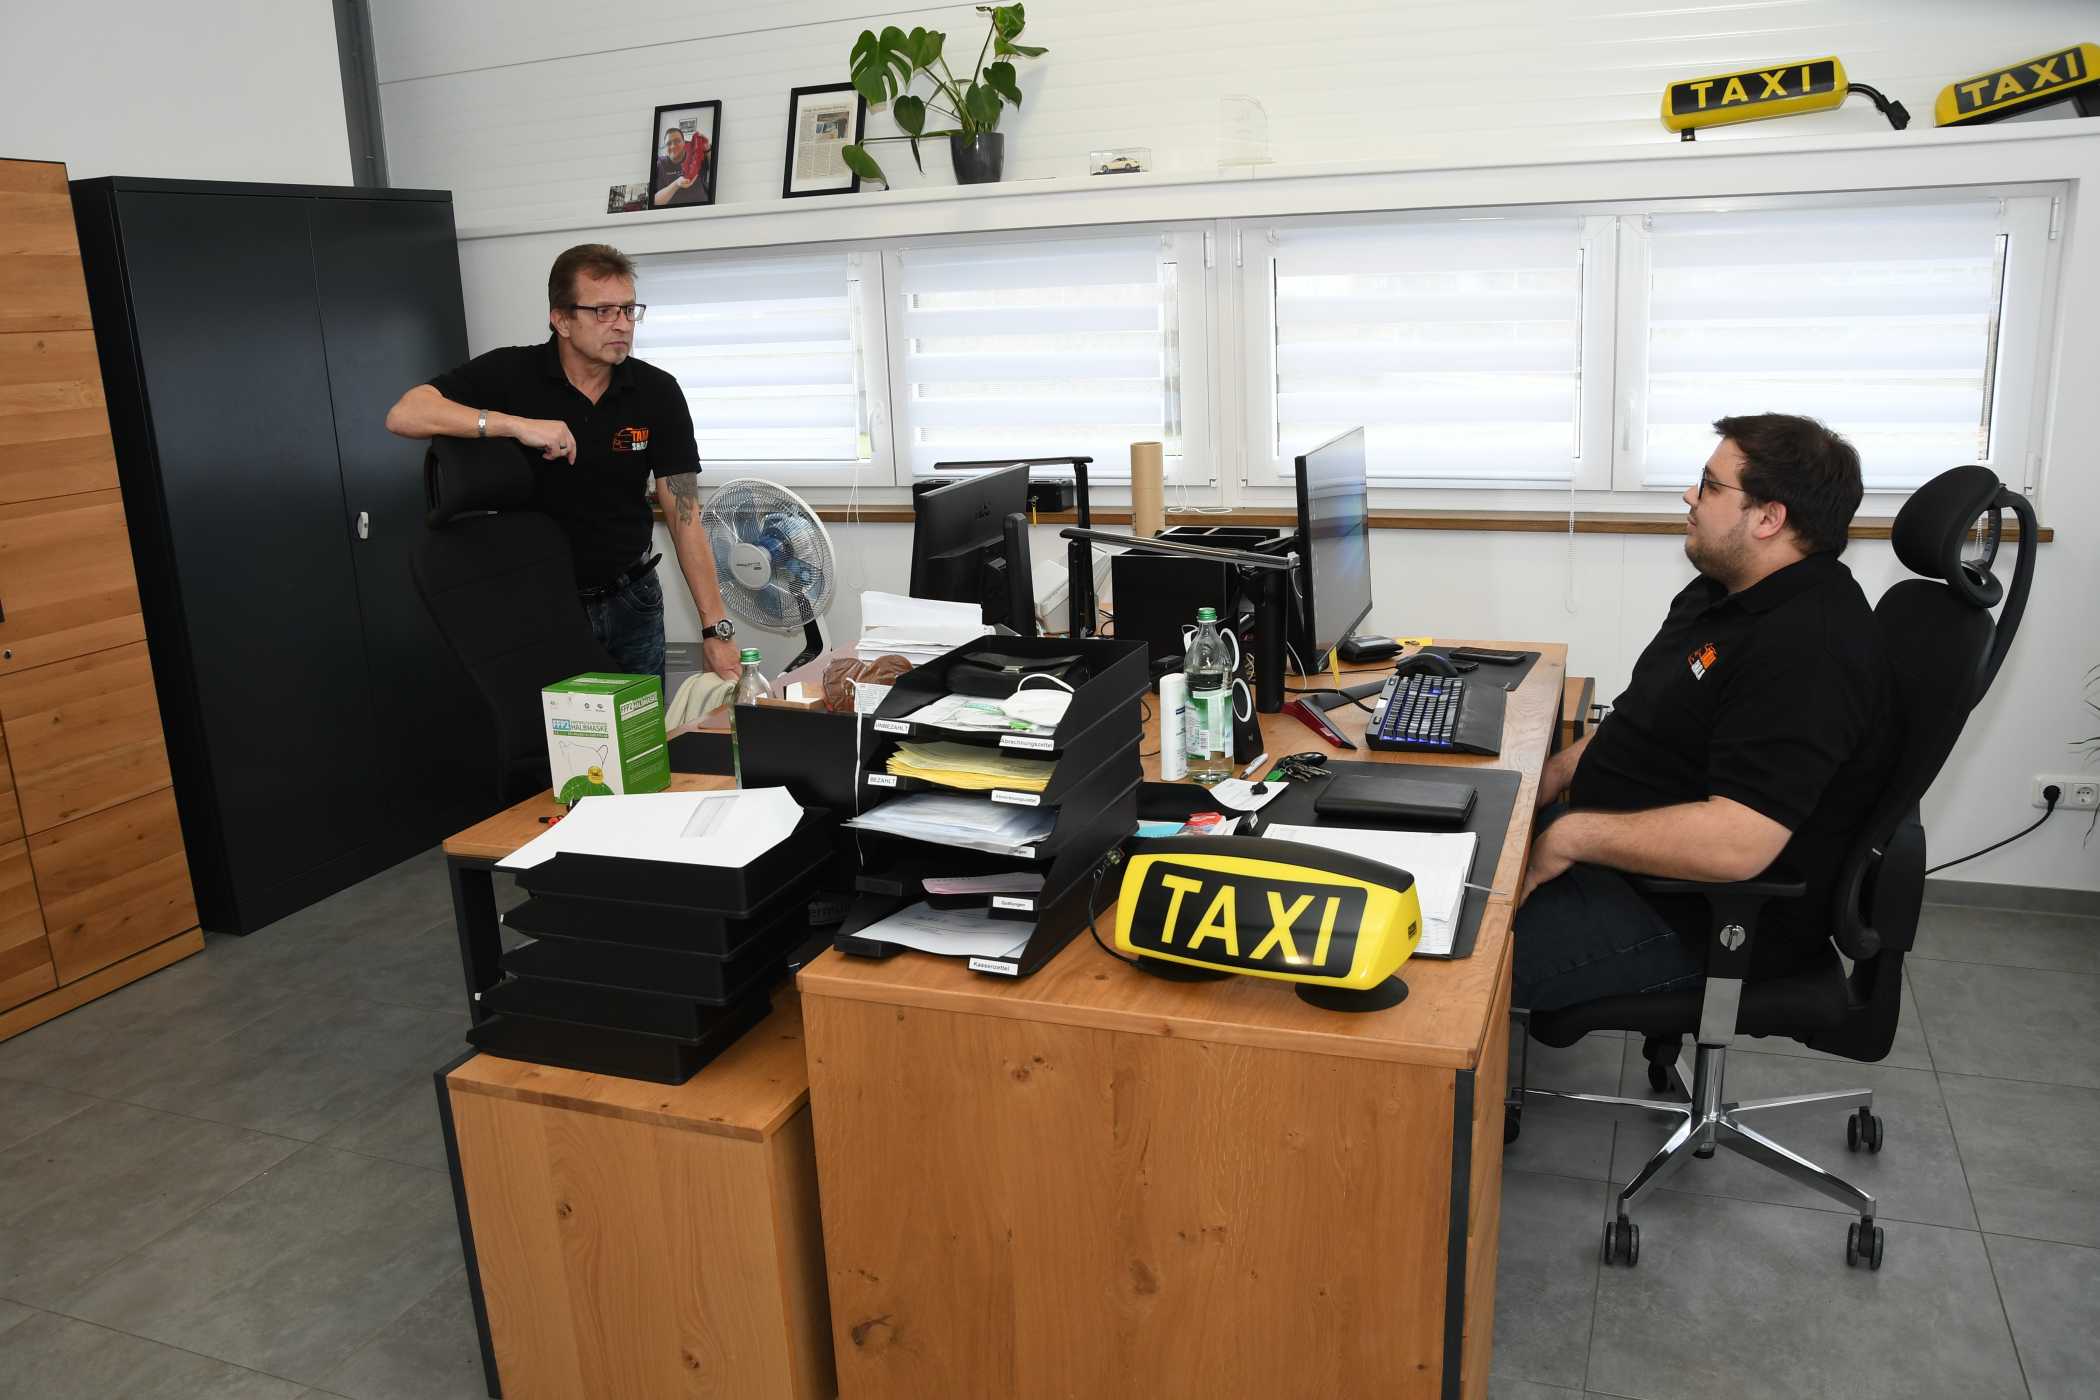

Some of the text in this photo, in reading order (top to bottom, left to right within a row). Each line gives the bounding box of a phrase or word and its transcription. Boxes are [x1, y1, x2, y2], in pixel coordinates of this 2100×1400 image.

[1690, 65, 1811, 108] TAXI
[1960, 52, 2080, 107] TAXI
[870, 775, 895, 785] BEZAHLT
[1161, 873, 1341, 967] TAXI
